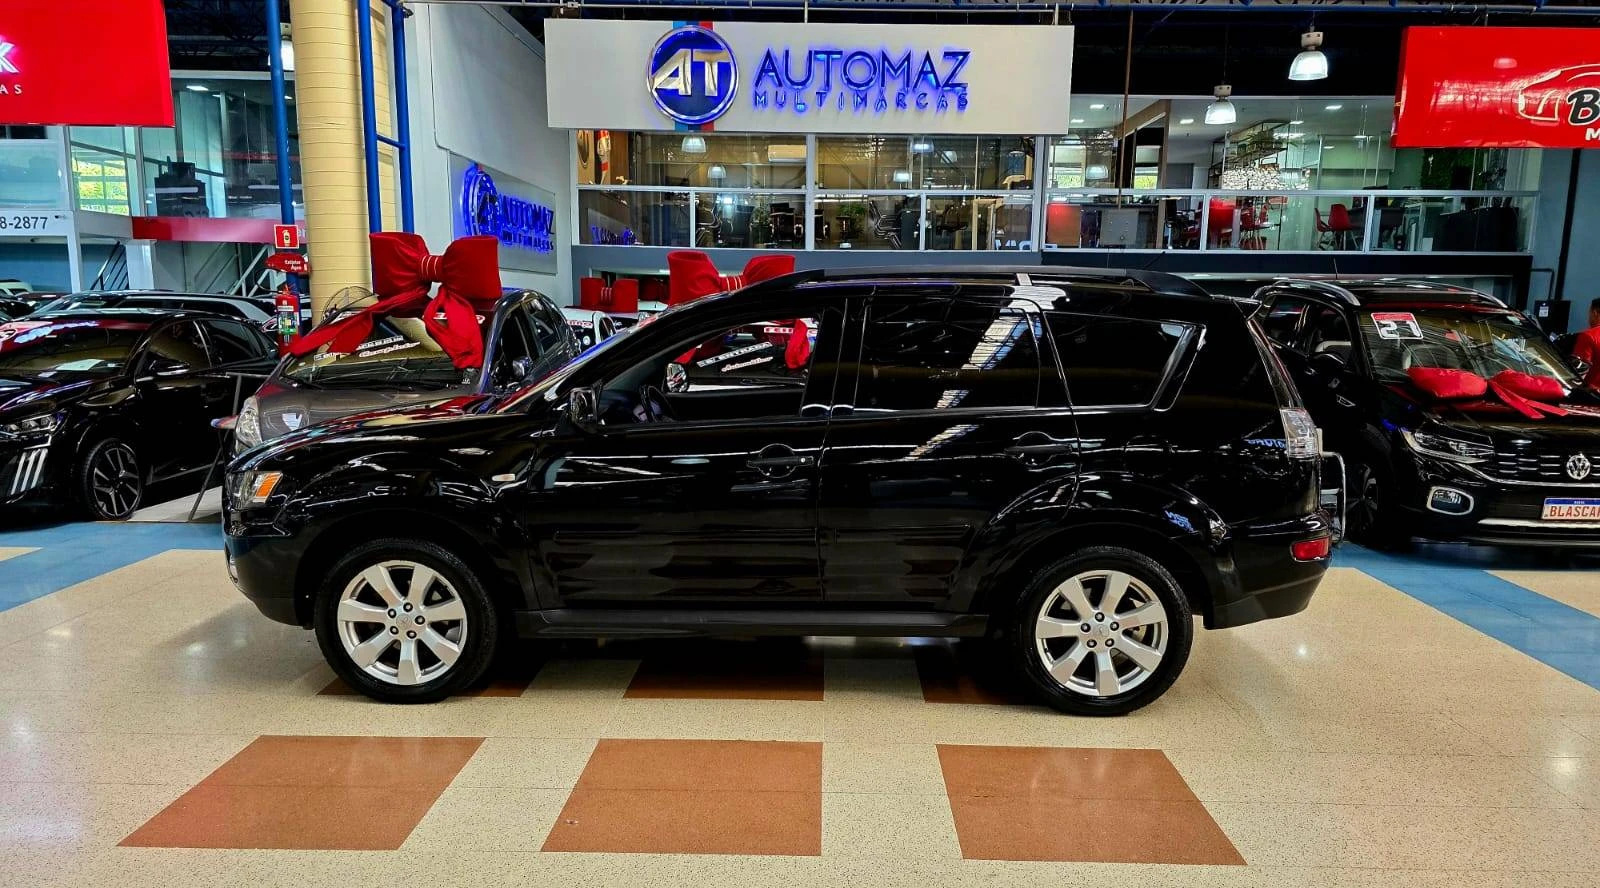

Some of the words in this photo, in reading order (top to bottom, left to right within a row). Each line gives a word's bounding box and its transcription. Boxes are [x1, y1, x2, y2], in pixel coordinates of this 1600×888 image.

[652, 48, 732, 97] AT
[754, 48, 971, 89] AUTOMAZ
[754, 91, 969, 111] MULTIMARCAS
[0, 216, 48, 230] 8-2877
